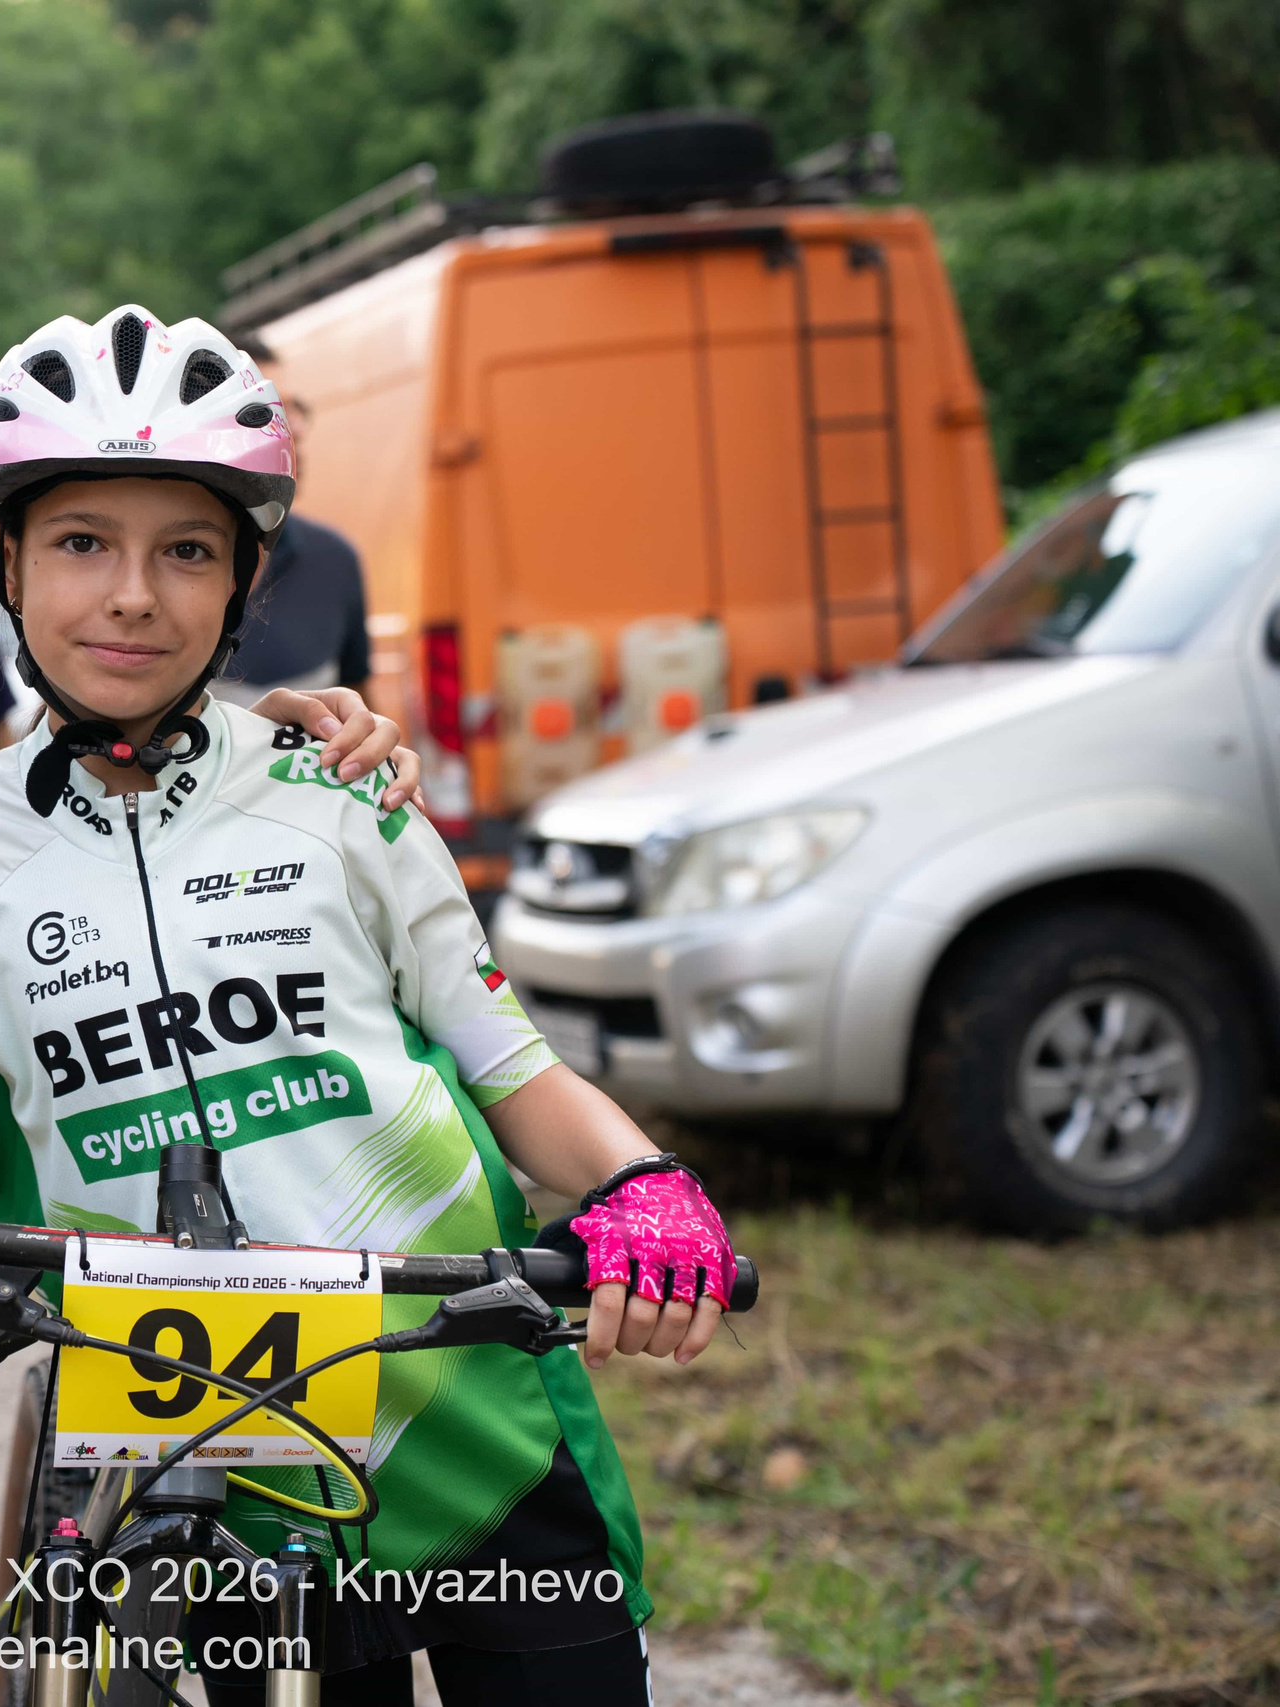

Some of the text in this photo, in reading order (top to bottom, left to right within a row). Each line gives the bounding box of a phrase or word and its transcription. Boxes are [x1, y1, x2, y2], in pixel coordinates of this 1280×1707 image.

[105, 442, 149, 451] ABUS
[225, 927, 312, 946] TRANSPRESS
[33, 972, 325, 1099] BEROE
[81, 1068, 350, 1166] cycling club
[82, 1269, 133, 1284] National
[136, 1273, 221, 1290] Championship
[224, 1277, 250, 1289] XCO
[252, 1278, 287, 1290] 2026
[300, 1278, 365, 1292] Knyazhevo
[127, 1308, 308, 1420] 94
